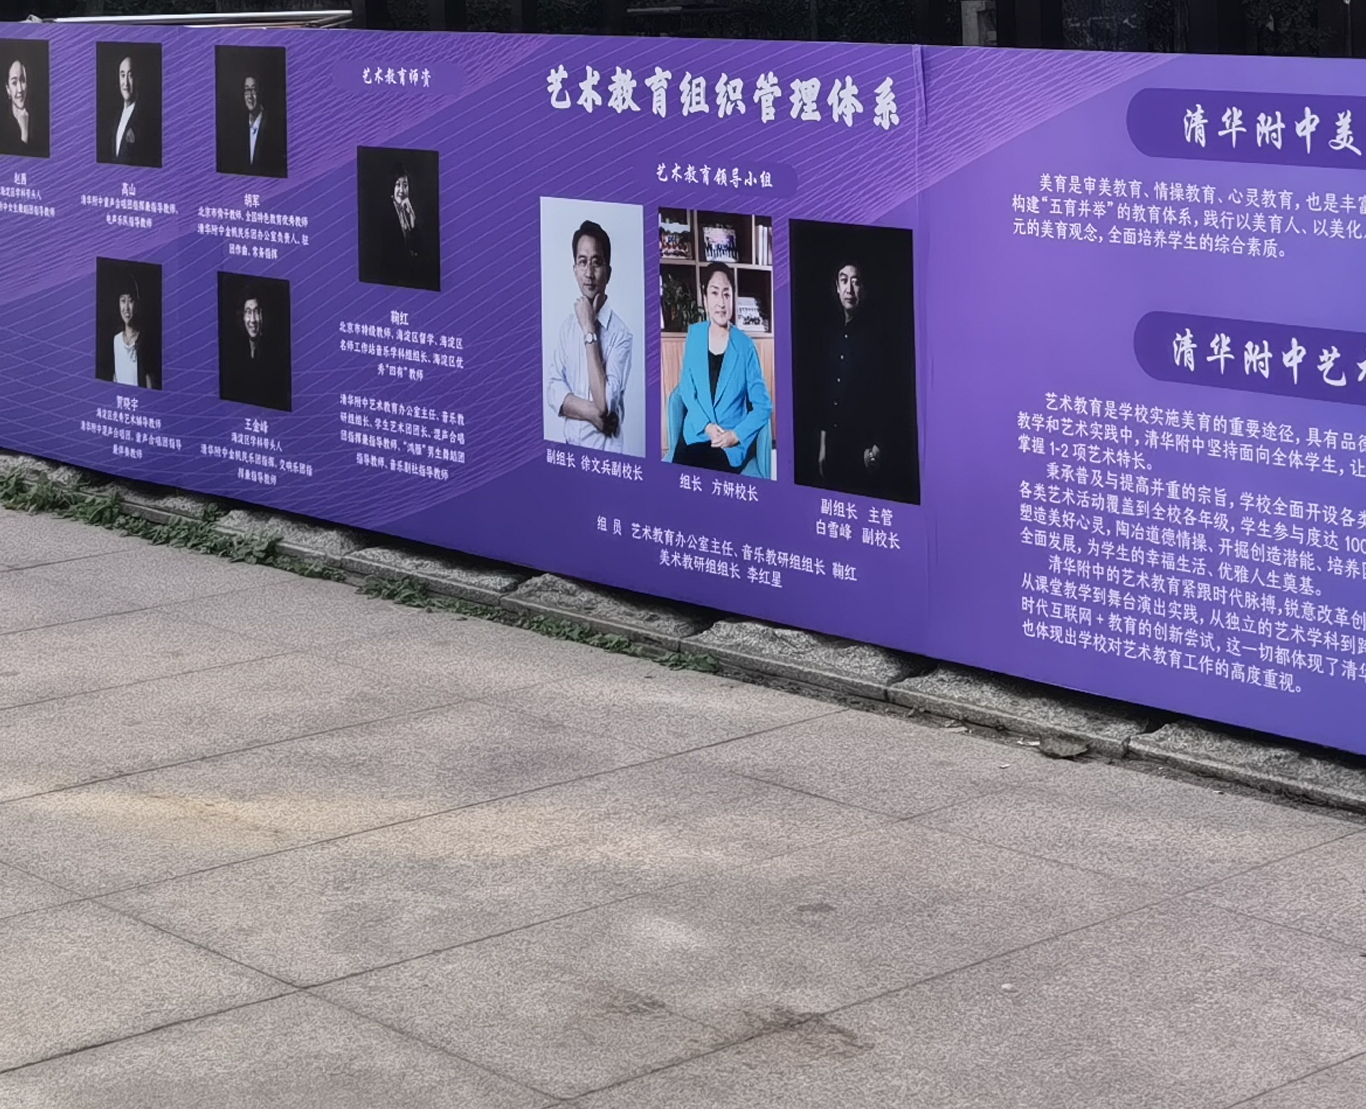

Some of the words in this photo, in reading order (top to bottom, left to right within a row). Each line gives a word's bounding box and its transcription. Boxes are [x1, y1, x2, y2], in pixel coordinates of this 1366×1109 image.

[362, 67, 432, 87] 艺术教育师资
[546, 64, 900, 130] 艺术教育组织管理体系
[656, 162, 773, 189] 艺术教育领导小组
[1013, 218, 1286, 258] 元的美育观念，全面培养学生的综合素质。
[546, 449, 576, 469] 副组长
[581, 457, 643, 482] 徐文兵副校长
[680, 473, 702, 493] 组长
[712, 479, 759, 503] 方妍校长
[821, 499, 858, 521] 副组长
[869, 506, 893, 527] 主管
[631, 523, 826, 576] 艺术教育办公室主任、音乐教研组组长
[816, 519, 852, 541] 白雪峰
[862, 527, 901, 550] 副校长
[659, 549, 741, 581] 美术教研组组长
[747, 566, 783, 589] 李红星
[1020, 525, 1322, 597] 全面发展，为学生的幸福生活、优雅人生奠基。
[1022, 619, 1302, 693] 也体现出学校对艺术教育工作的高度重视。
